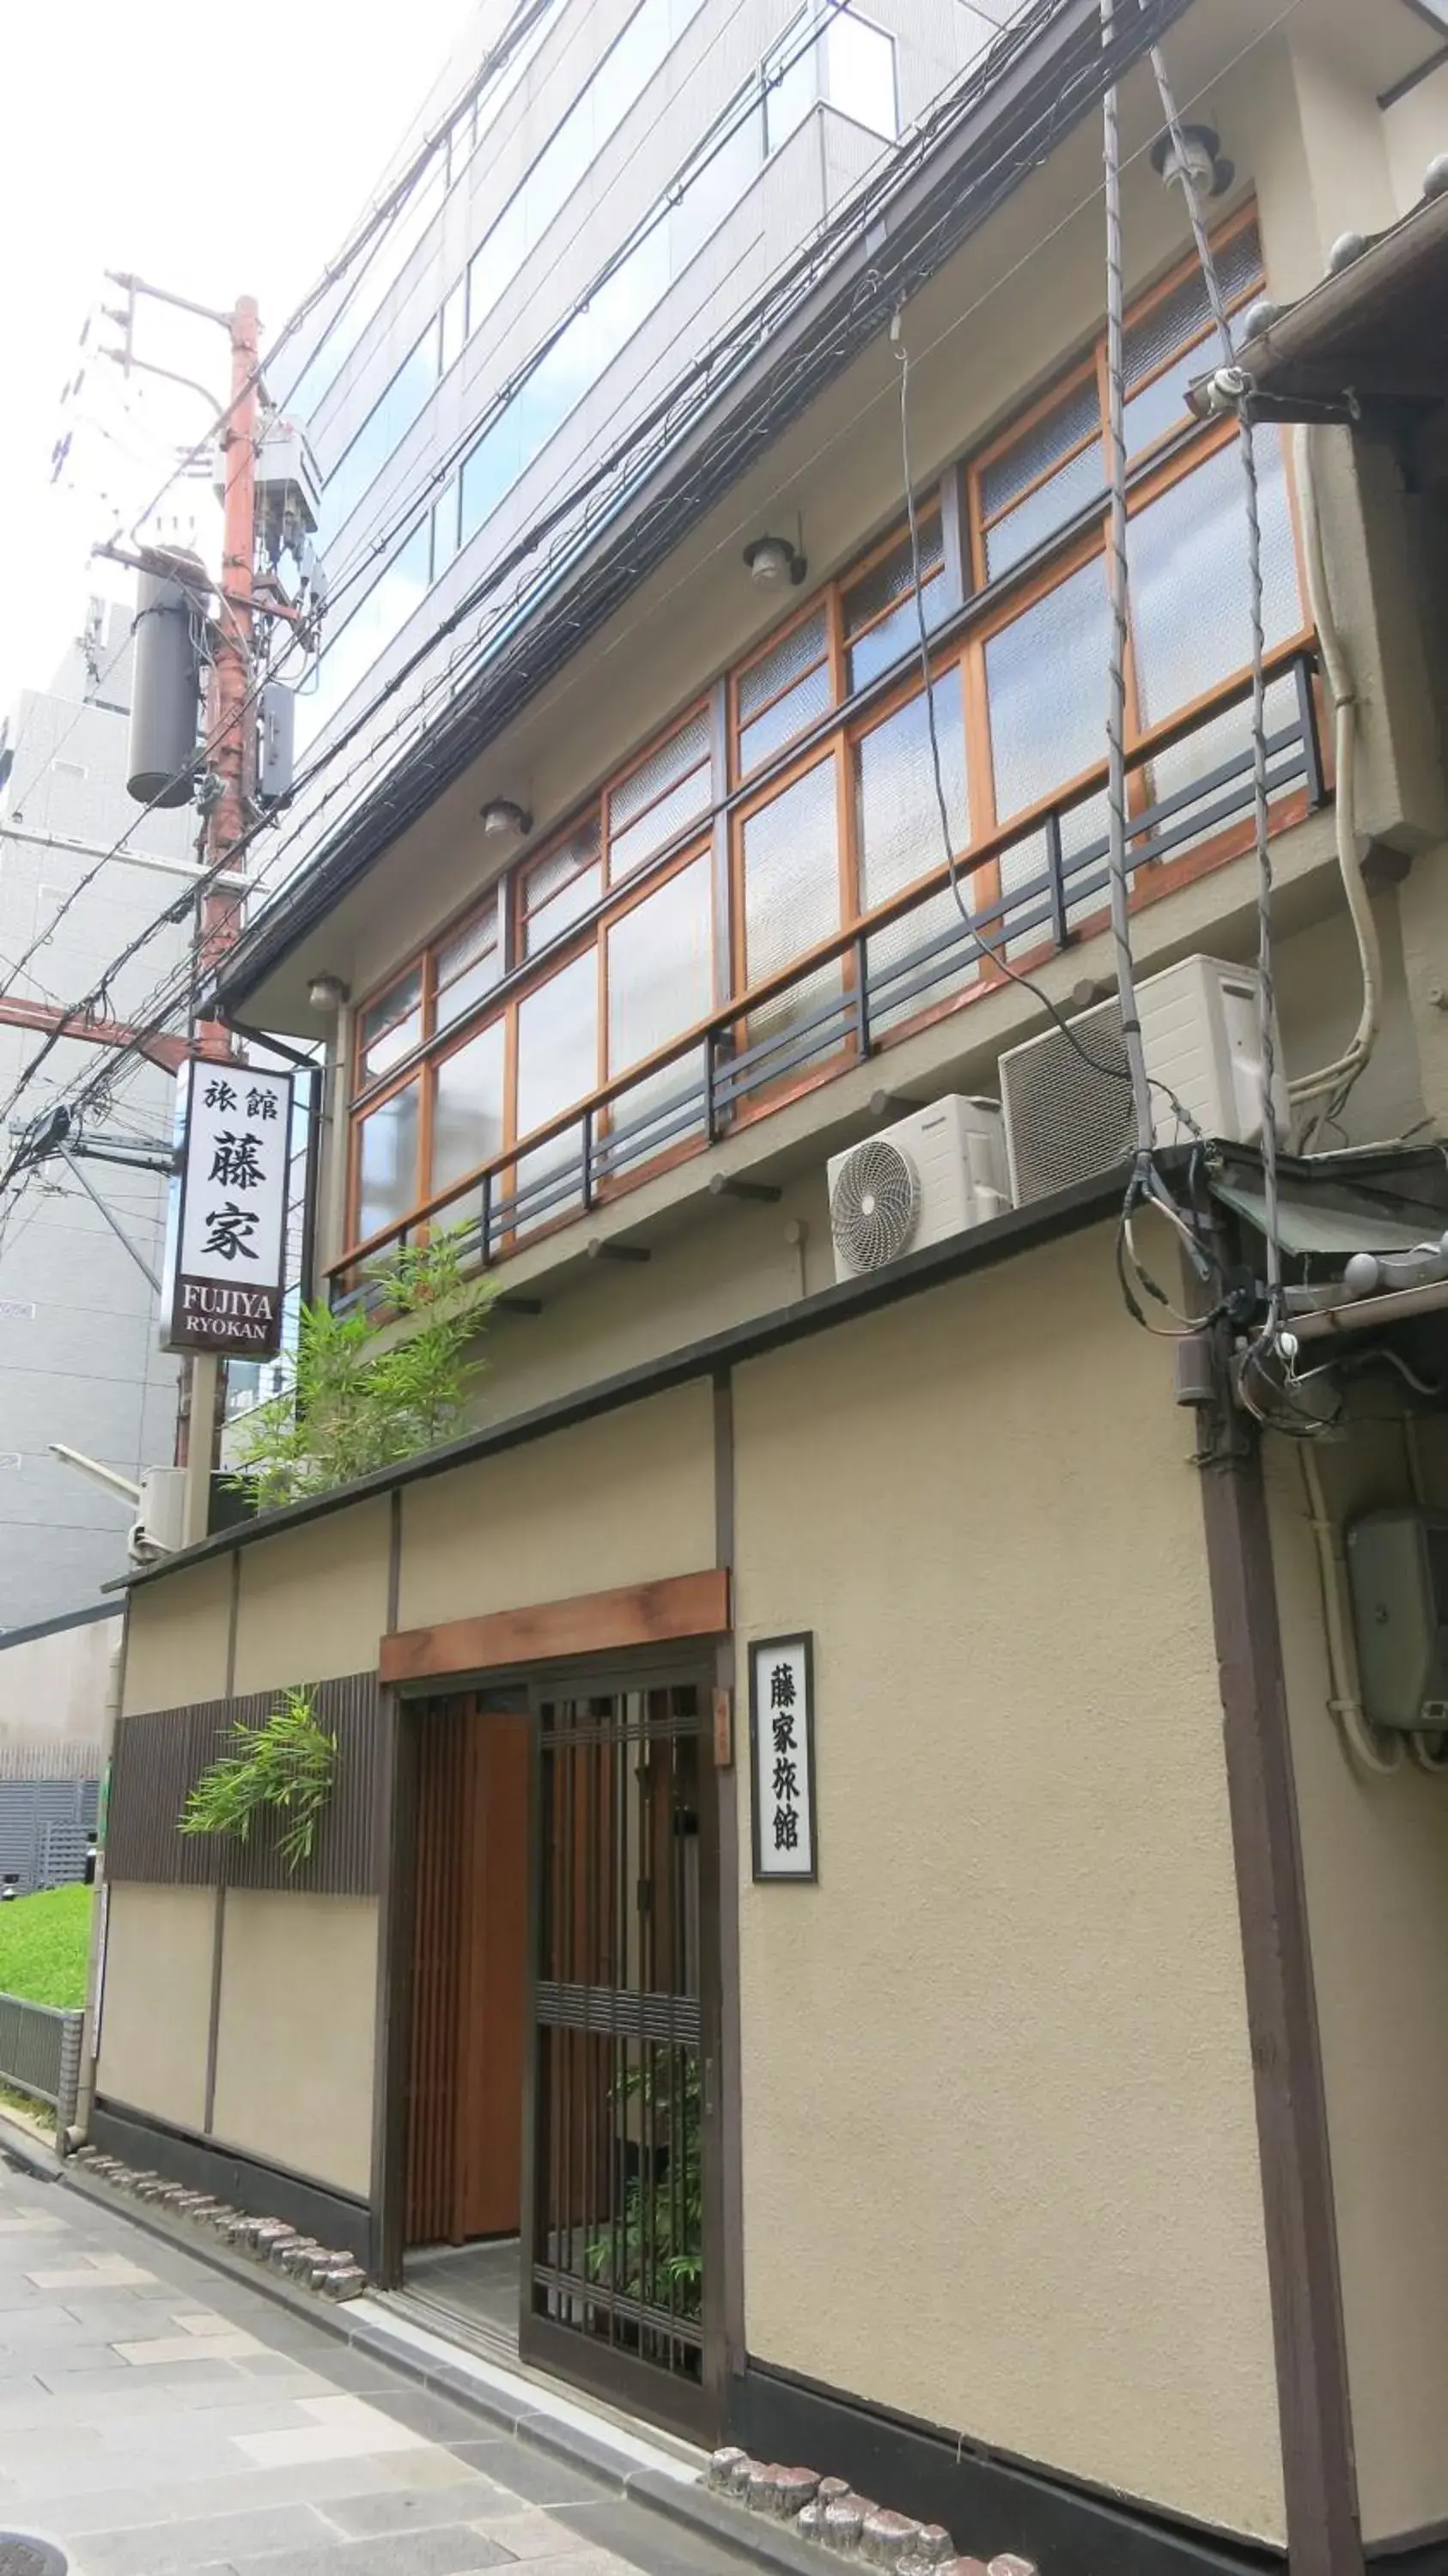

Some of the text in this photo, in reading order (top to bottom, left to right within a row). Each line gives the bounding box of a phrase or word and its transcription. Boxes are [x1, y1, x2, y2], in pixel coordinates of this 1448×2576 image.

[203, 1079, 279, 1121] 旅館
[201, 1129, 266, 1261] 藤家
[182, 1284, 273, 1320] FUJIYA
[186, 1315, 268, 1340] RYOKAN
[770, 1662, 800, 1852] 藤家旅館
